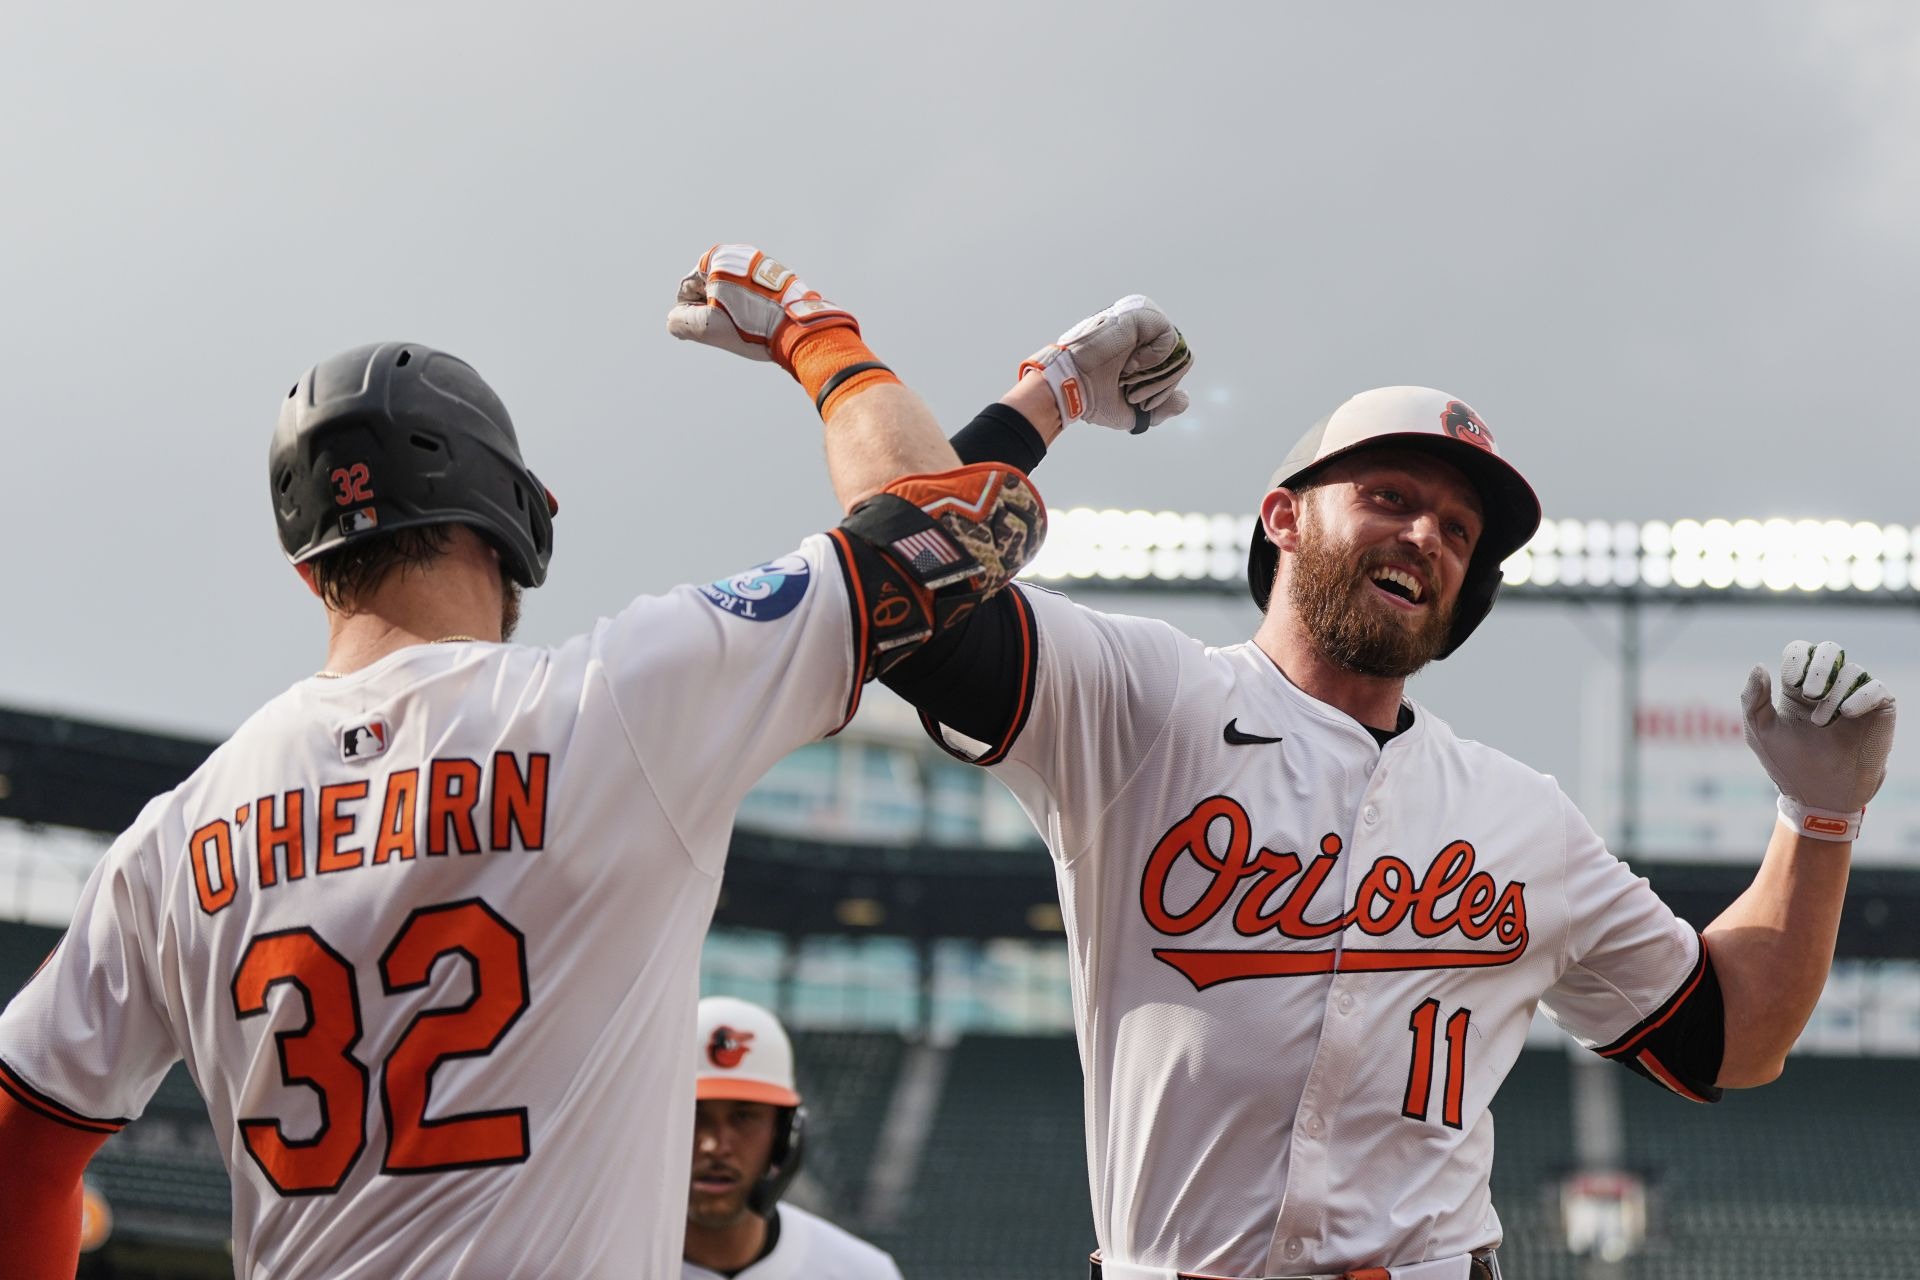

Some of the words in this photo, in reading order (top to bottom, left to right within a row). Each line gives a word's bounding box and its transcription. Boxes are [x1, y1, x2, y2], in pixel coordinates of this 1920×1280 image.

[331, 463, 374, 506] 32
[189, 751, 550, 916] O'HEARN
[1140, 794, 1530, 945] Orioles
[231, 896, 531, 1198] 32
[1401, 997, 1472, 1130] 11
